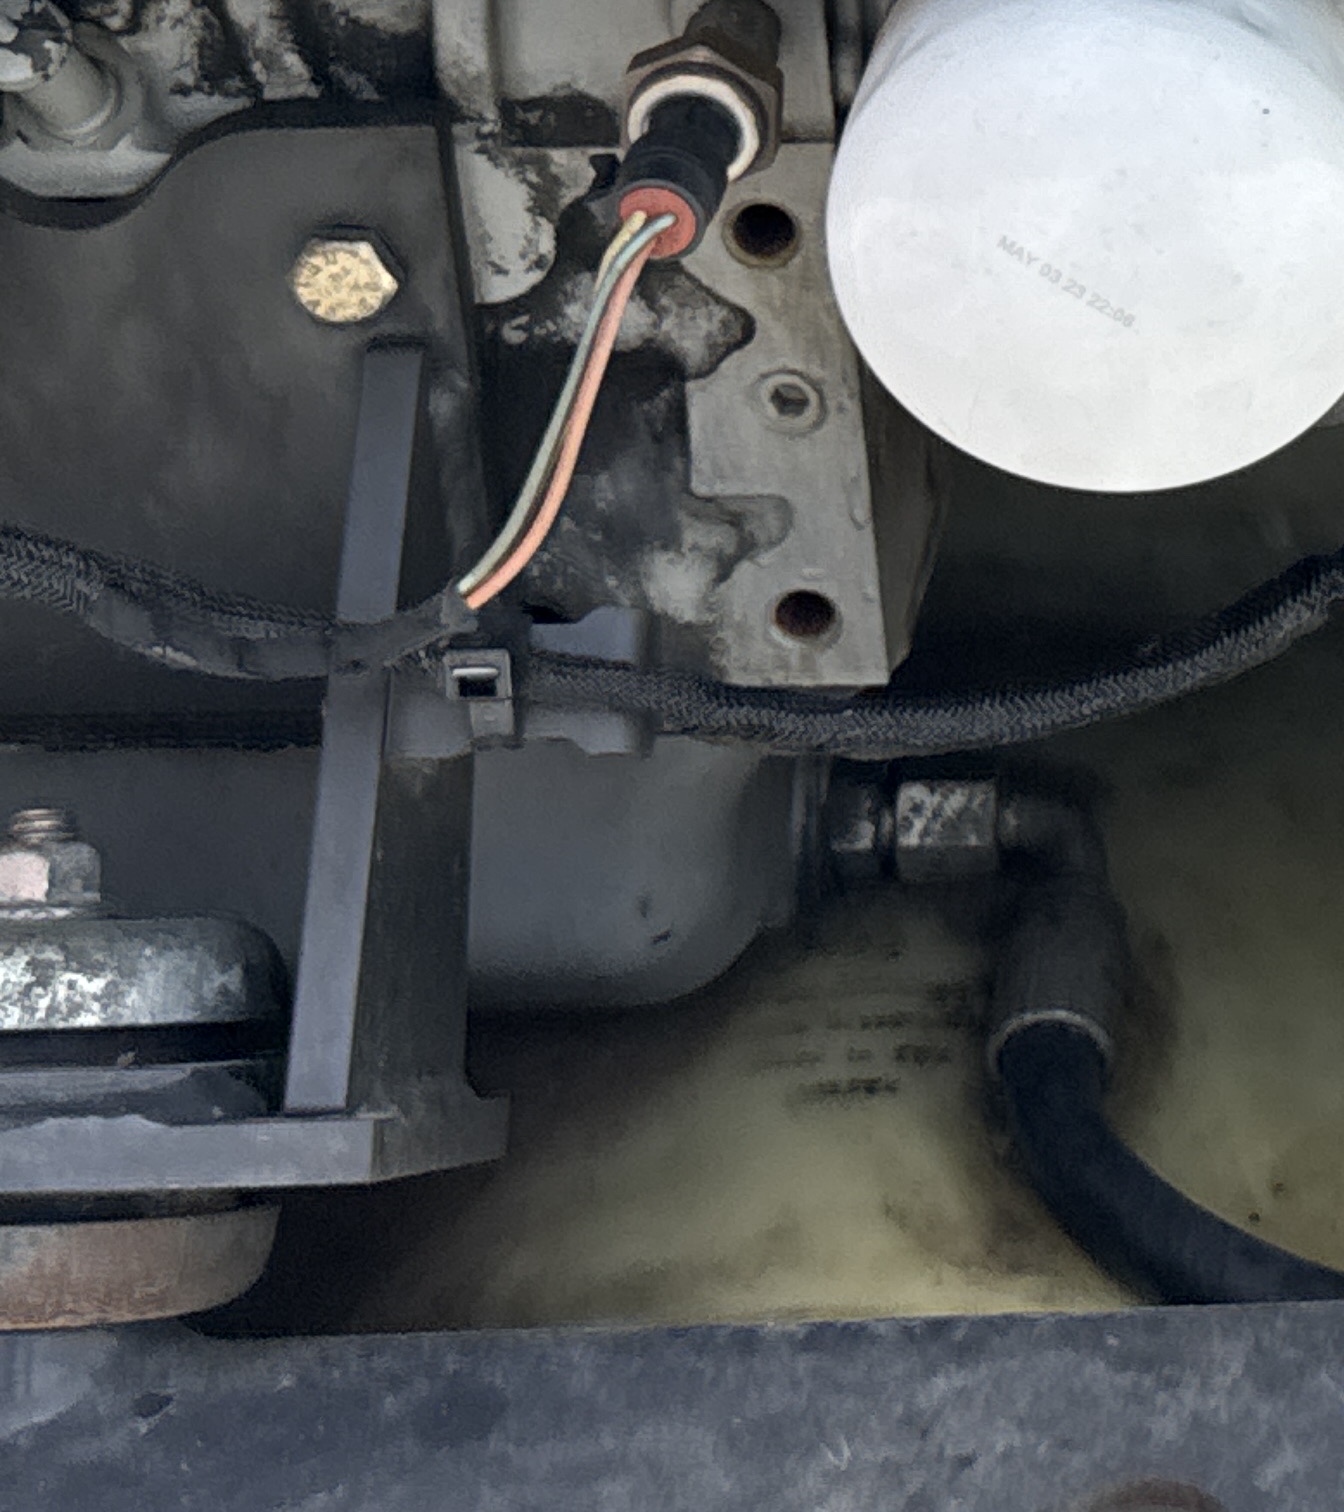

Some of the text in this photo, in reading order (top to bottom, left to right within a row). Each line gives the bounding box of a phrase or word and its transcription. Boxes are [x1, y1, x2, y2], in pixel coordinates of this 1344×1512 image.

[997, 235, 1040, 265] MAY
[1039, 263, 1062, 284] 03
[1062, 278, 1086, 299] 23
